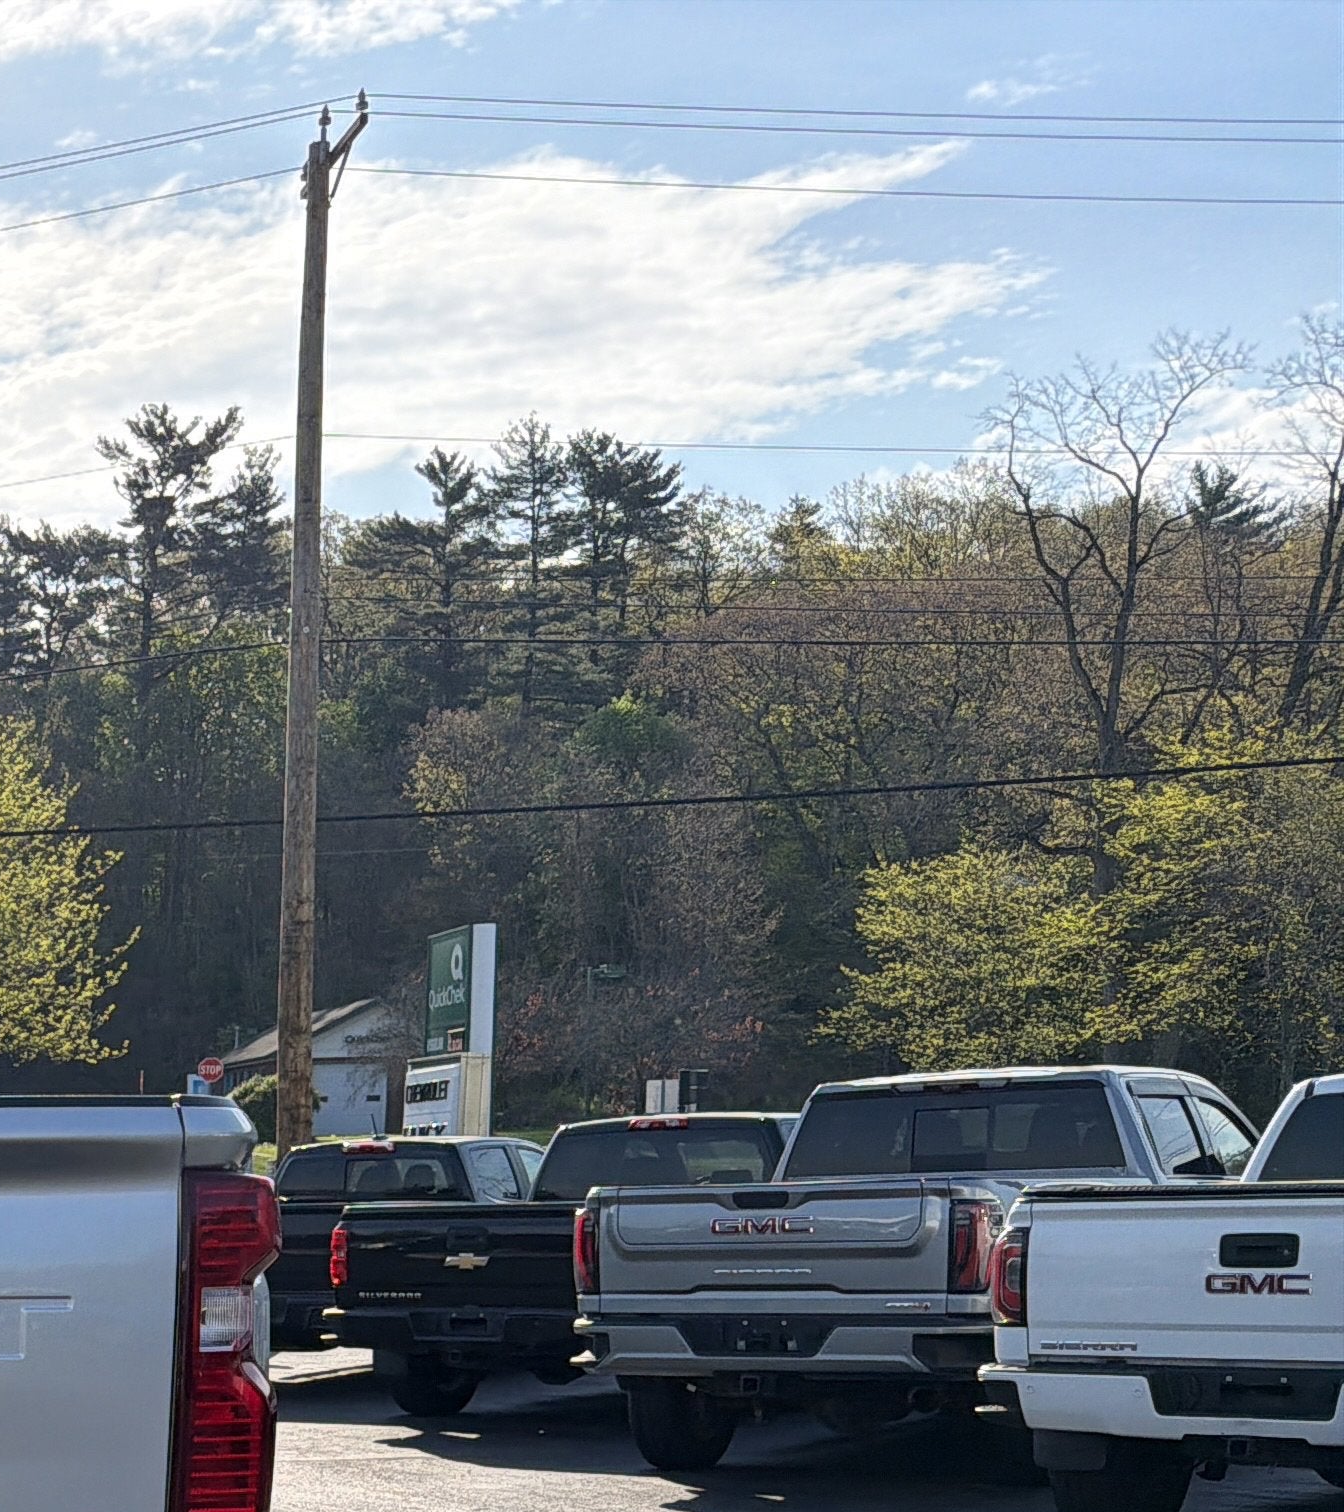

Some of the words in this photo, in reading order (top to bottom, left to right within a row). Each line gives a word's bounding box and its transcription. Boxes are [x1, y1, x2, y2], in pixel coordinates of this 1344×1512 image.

[428, 984, 465, 1011] QuickChek
[200, 1064, 222, 1075] STOP
[710, 1216, 814, 1234] GMC
[1205, 1273, 1313, 1295] GMC
